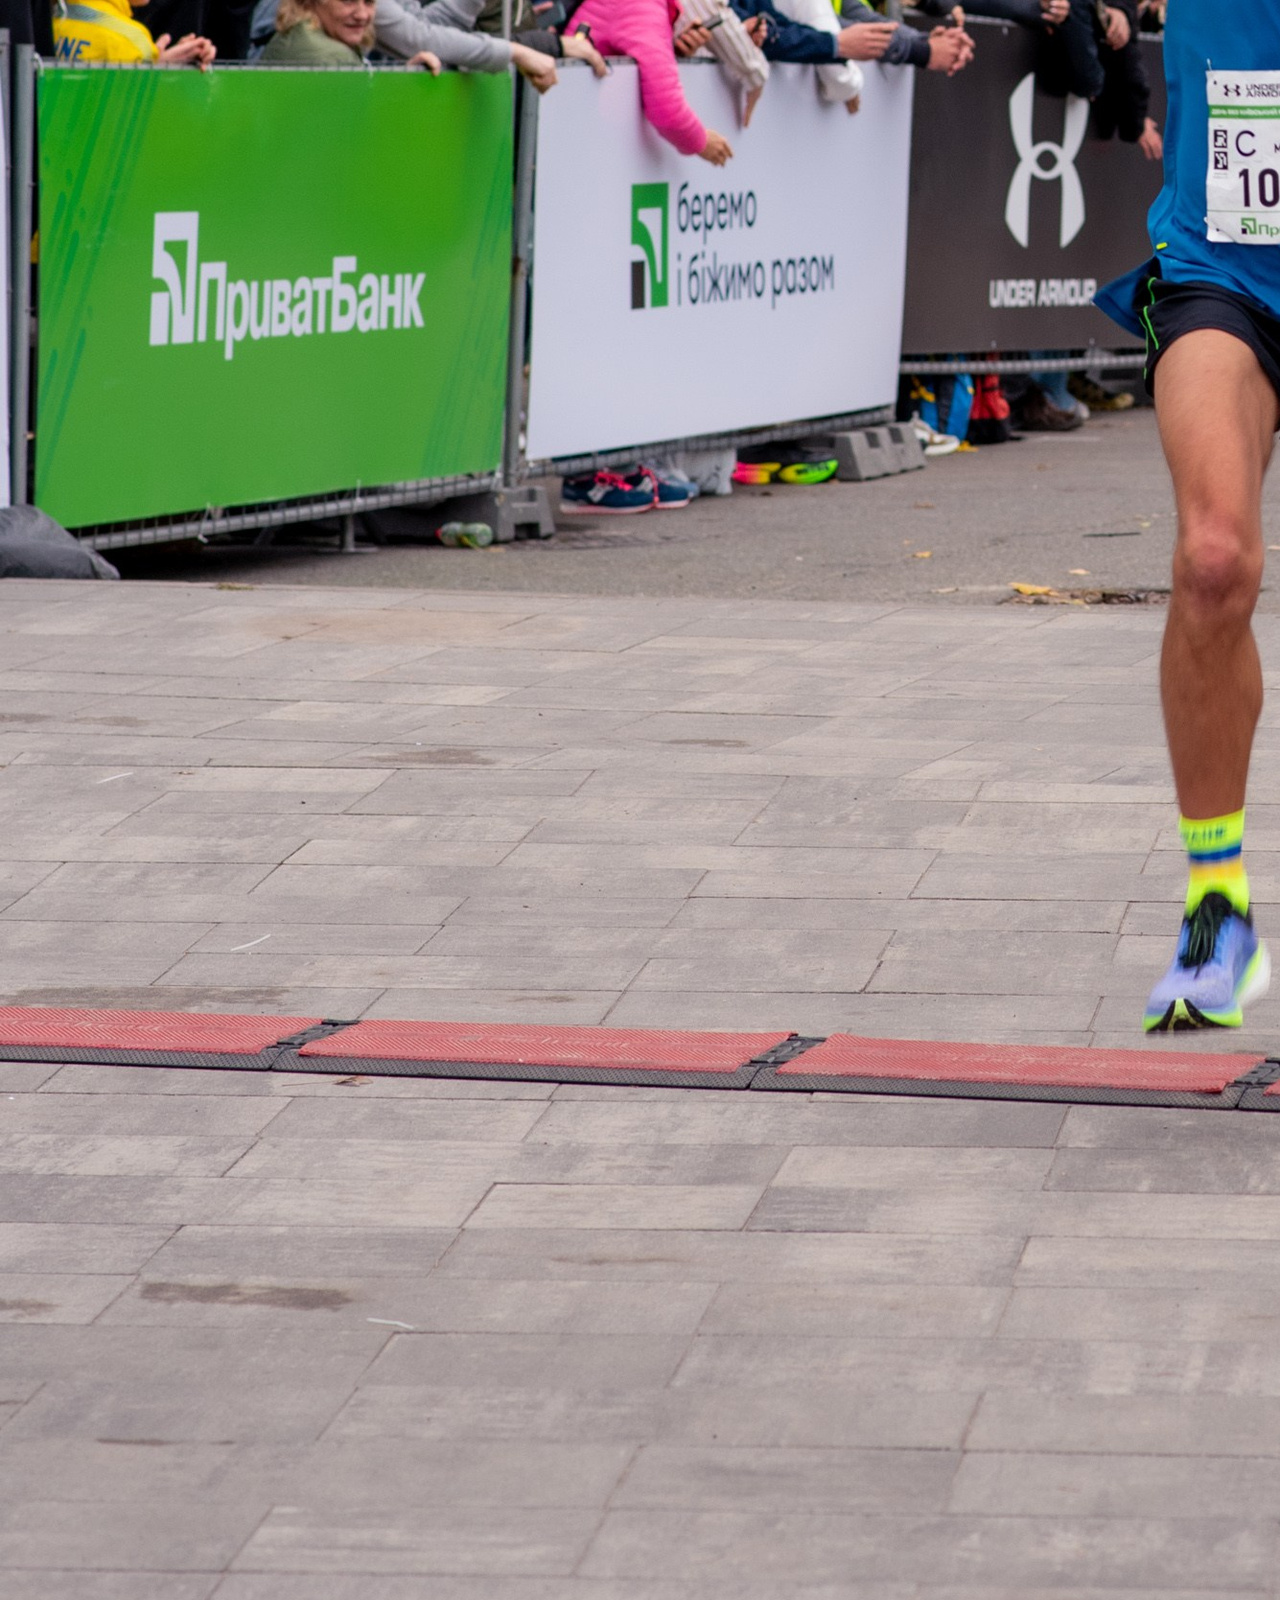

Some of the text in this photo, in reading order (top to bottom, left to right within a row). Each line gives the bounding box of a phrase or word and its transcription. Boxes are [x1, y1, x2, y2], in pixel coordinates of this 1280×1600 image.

[677, 181, 757, 245] беремо
[677, 250, 835, 311] і біжимо разом
[989, 278, 1098, 309] UNDER ARMOUR
